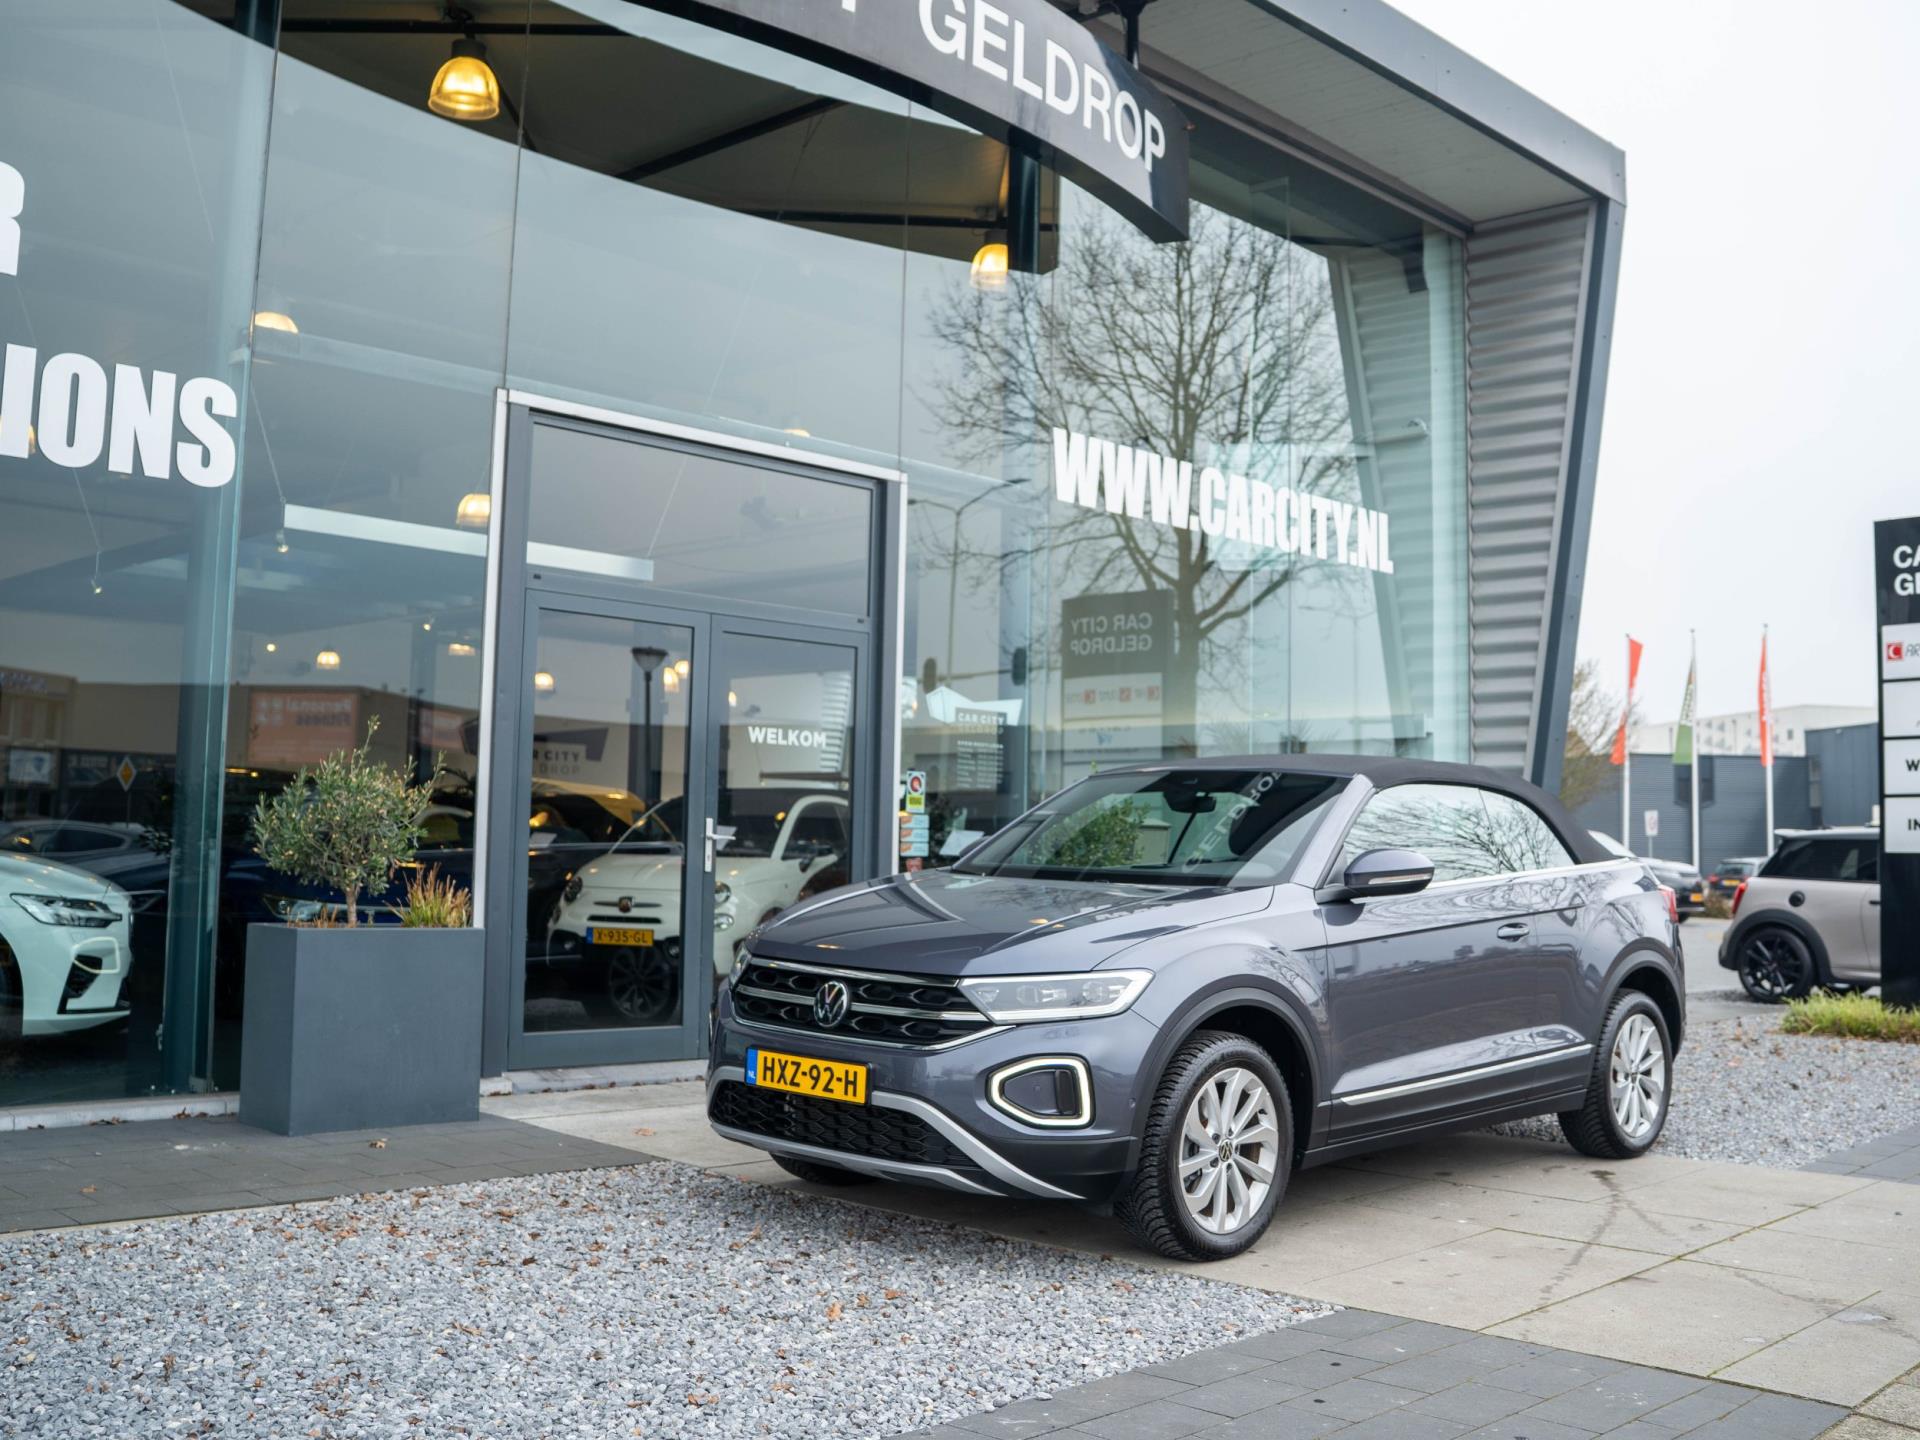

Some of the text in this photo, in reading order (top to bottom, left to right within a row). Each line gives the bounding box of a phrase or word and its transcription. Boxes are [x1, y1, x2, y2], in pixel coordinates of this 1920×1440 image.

[919, 0, 1166, 173] GELDROP
[1053, 427, 1394, 575] WWW.CARCITY.NL
[748, 726, 827, 748] WELKOM
[763, 1056, 858, 1098] HXZ-92-H
